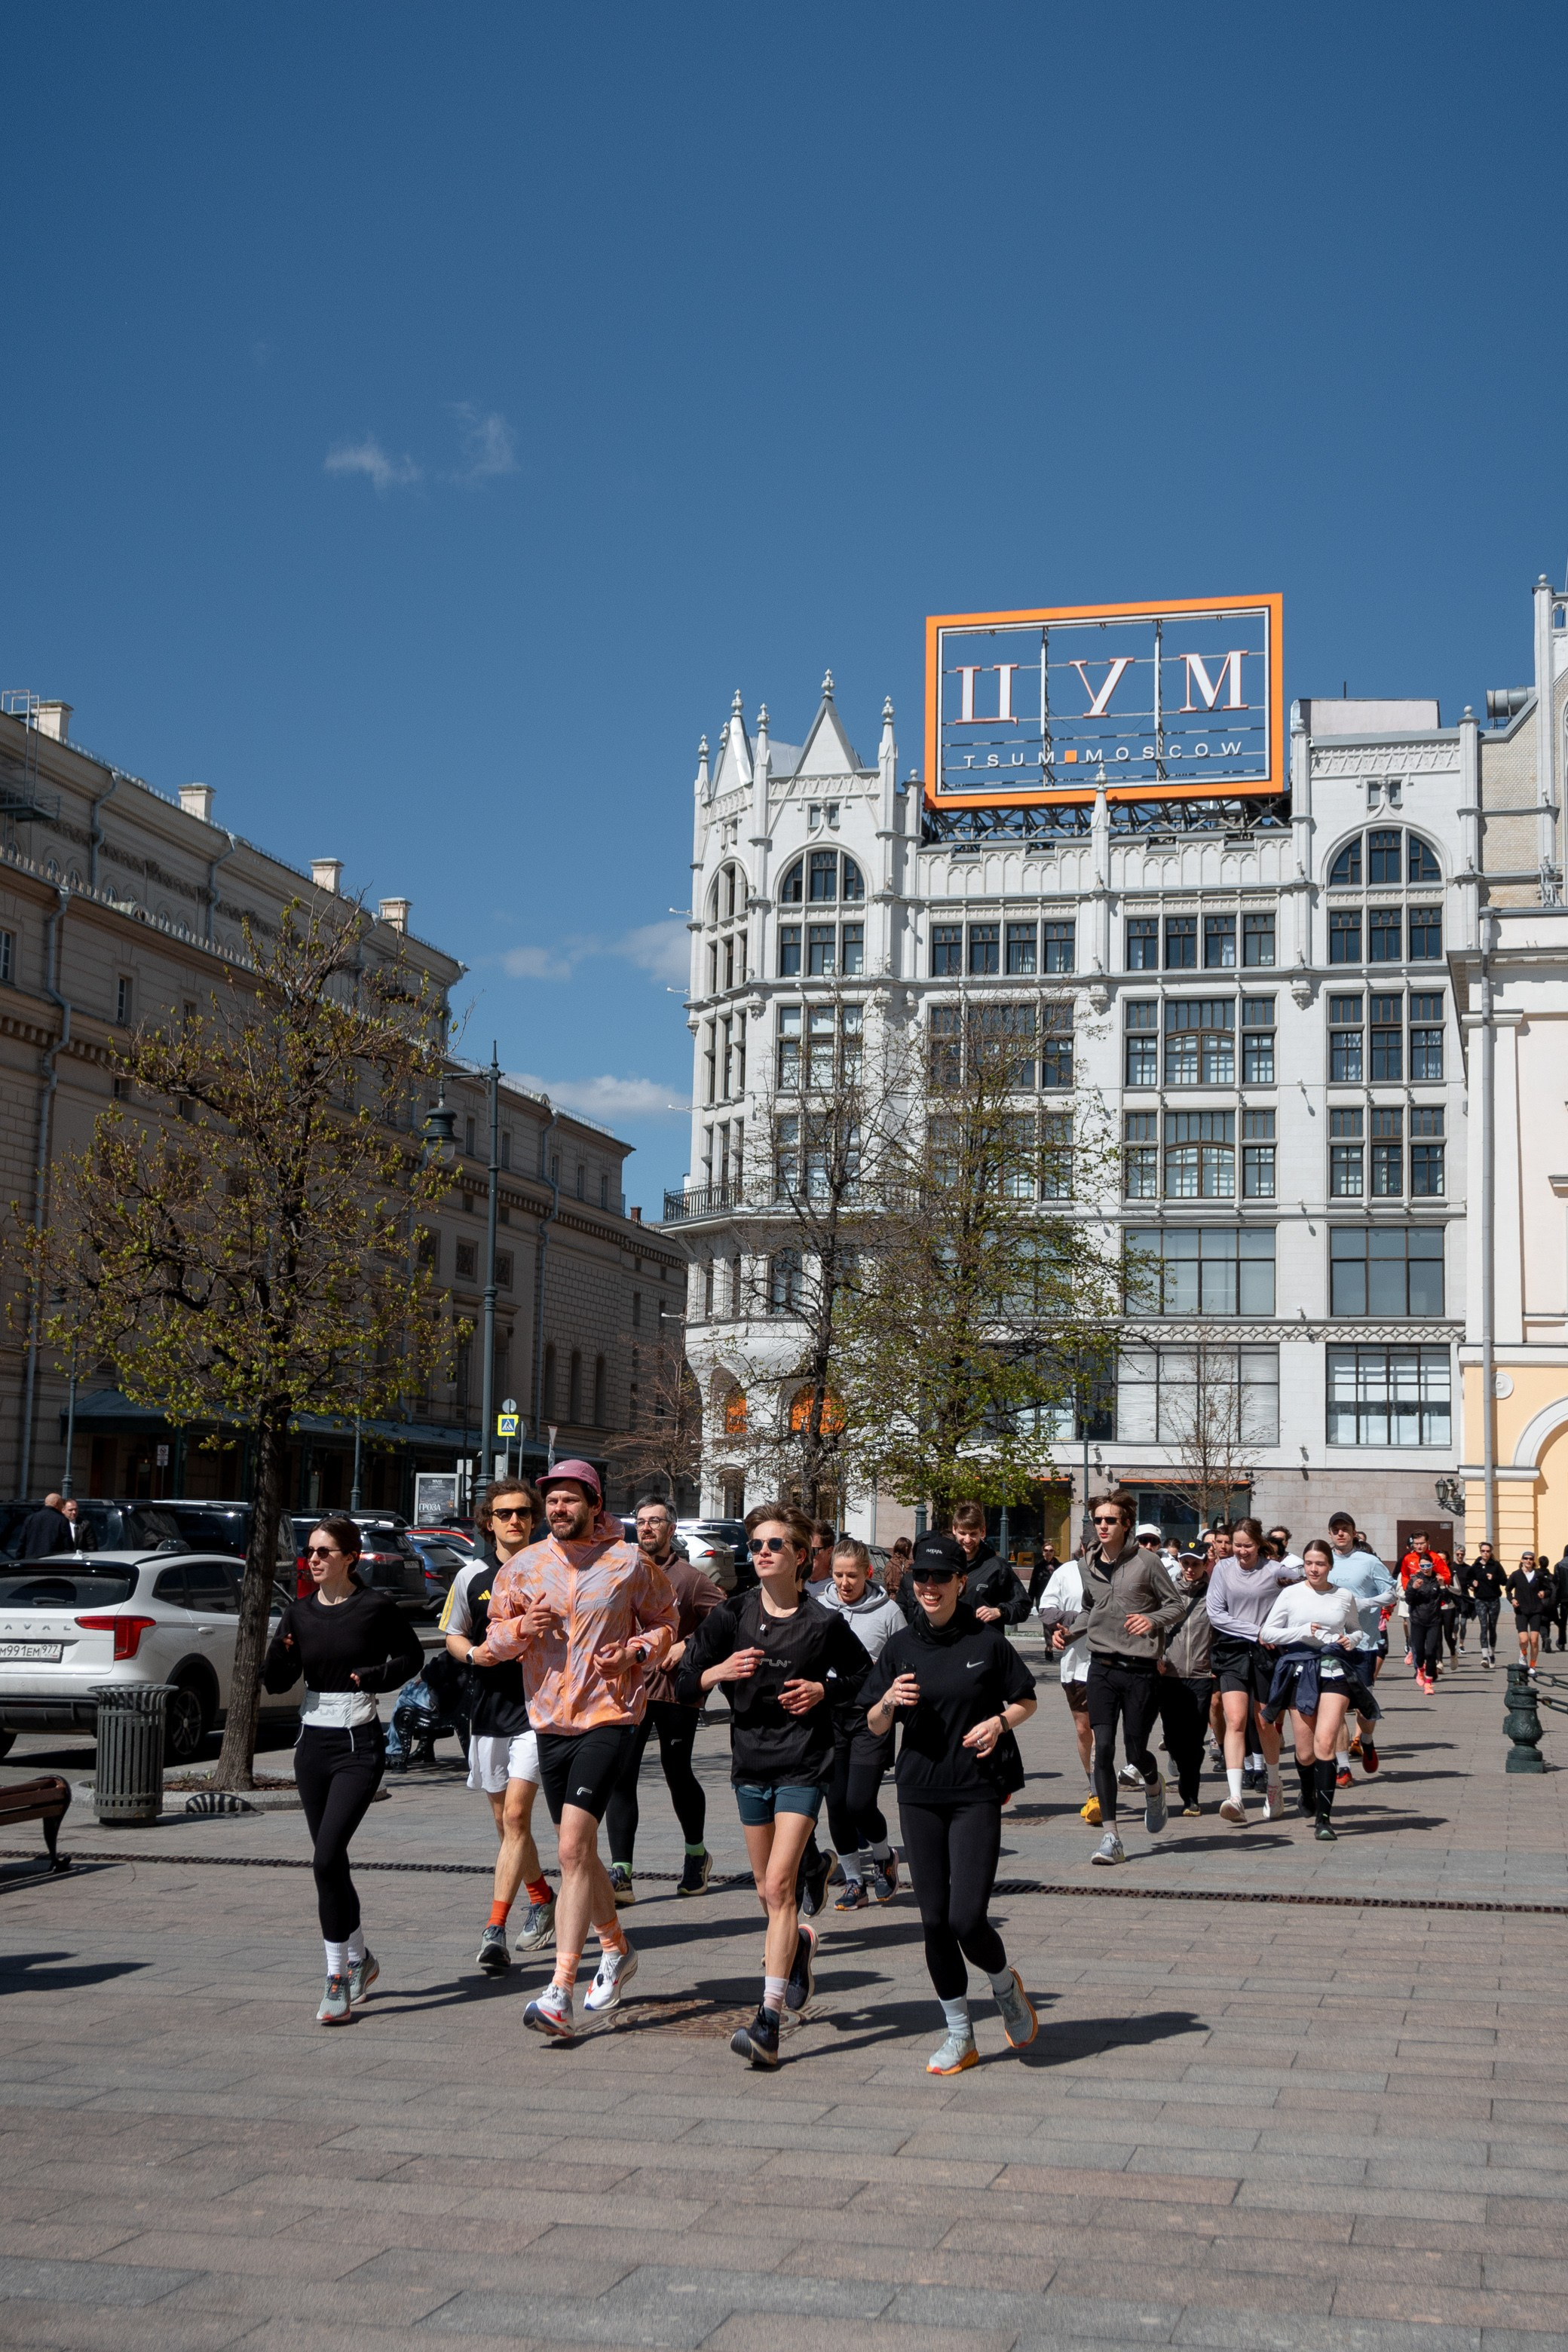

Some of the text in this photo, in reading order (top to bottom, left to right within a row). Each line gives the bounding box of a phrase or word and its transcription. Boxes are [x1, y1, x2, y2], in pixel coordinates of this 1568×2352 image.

[955, 650, 1249, 726] ЦУМ
[963, 741, 1242, 768] TSUM MOSCOW
[418, 1502, 441, 1511] ГРОЗА
[41, 1645, 58, 1653] 977
